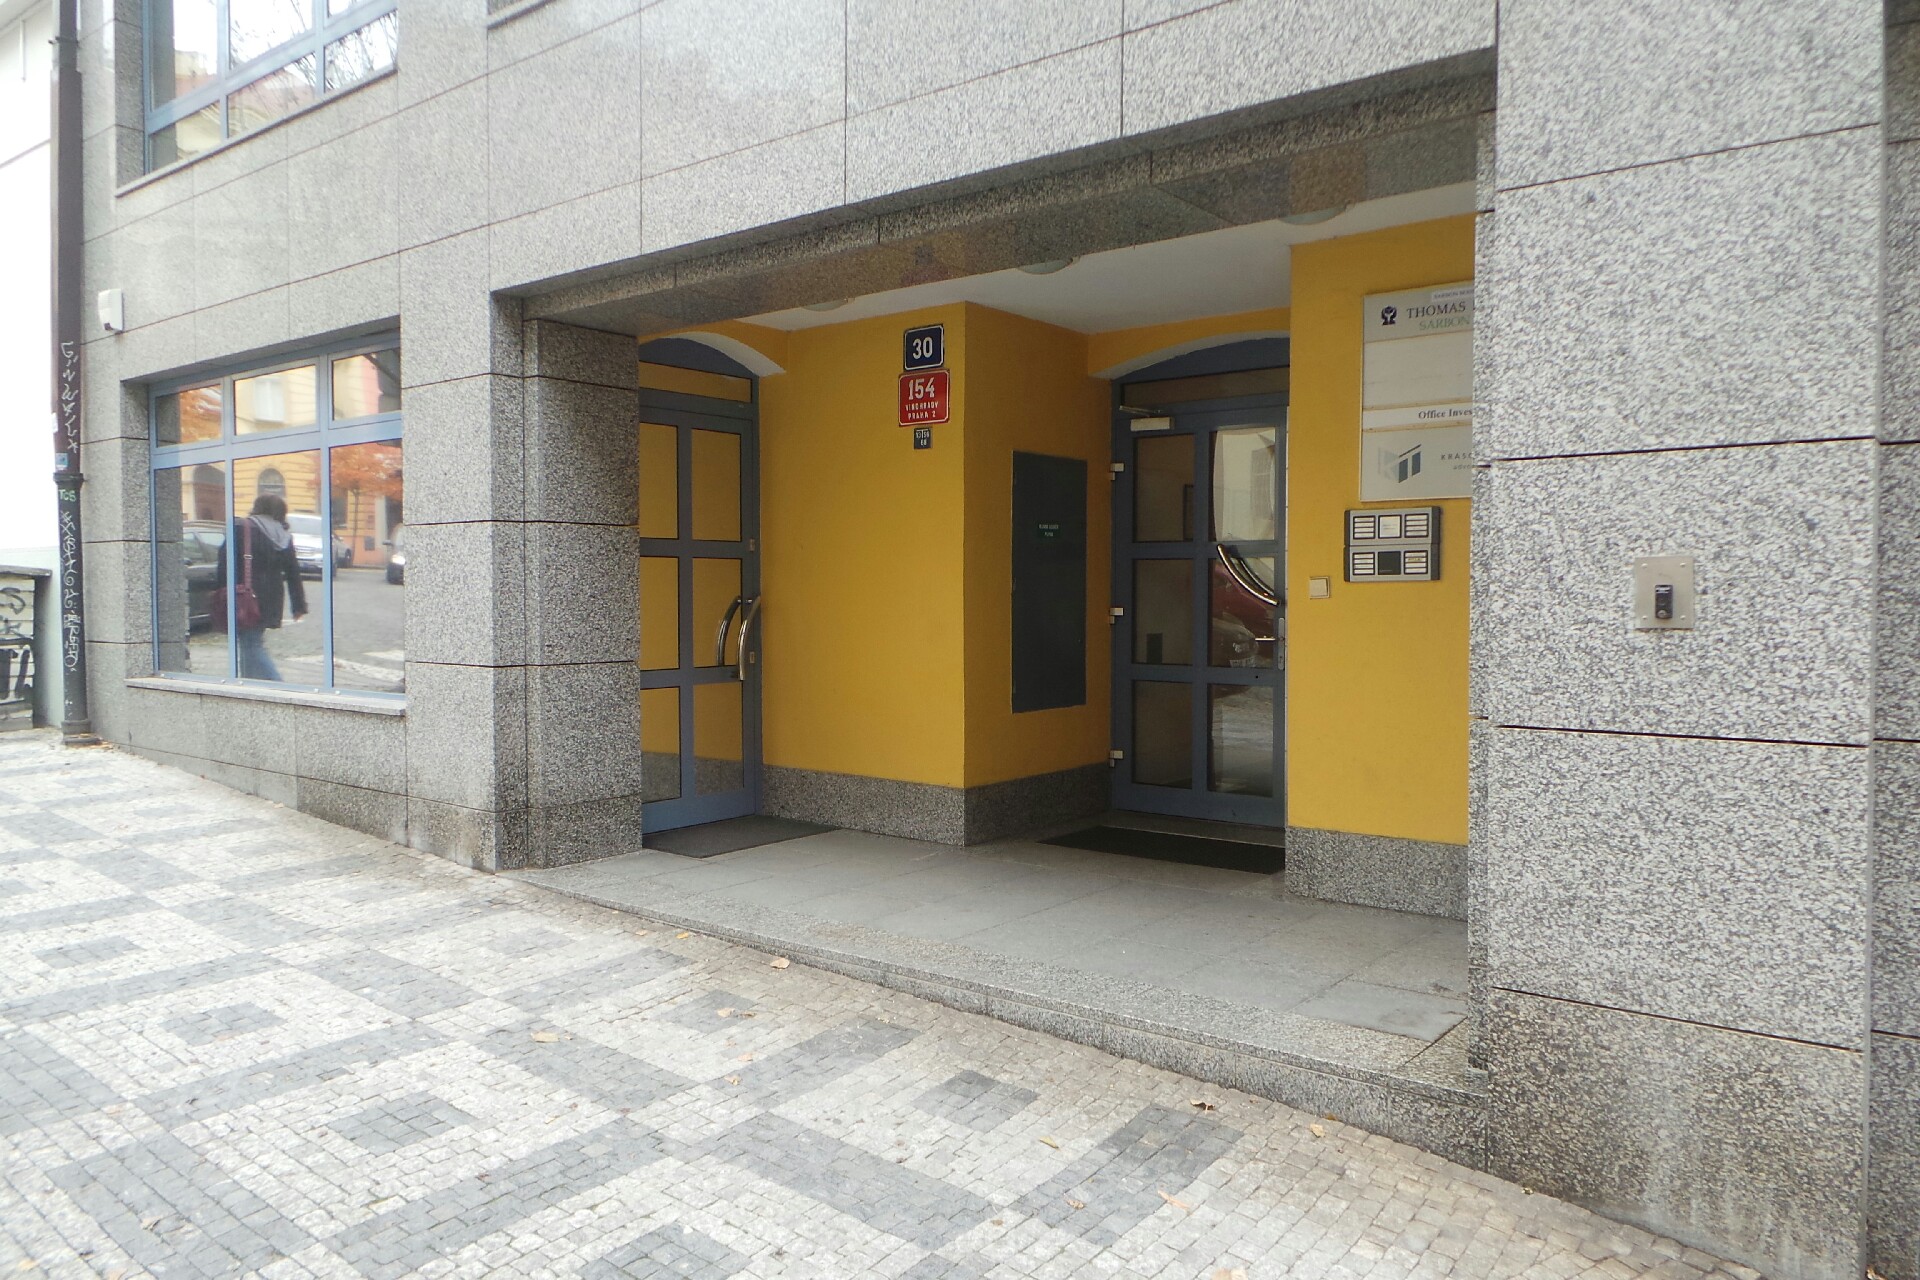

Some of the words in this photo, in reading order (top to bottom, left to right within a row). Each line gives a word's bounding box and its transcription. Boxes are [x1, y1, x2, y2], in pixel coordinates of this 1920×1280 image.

[1406, 301, 1467, 319] THOMAS
[912, 337, 933, 359] 30
[908, 377, 935, 400] 154
[905, 401, 939, 411] VINOHRADY
[907, 411, 929, 420] PRAHA
[931, 410, 936, 418] 2
[1418, 408, 1446, 420] Office
